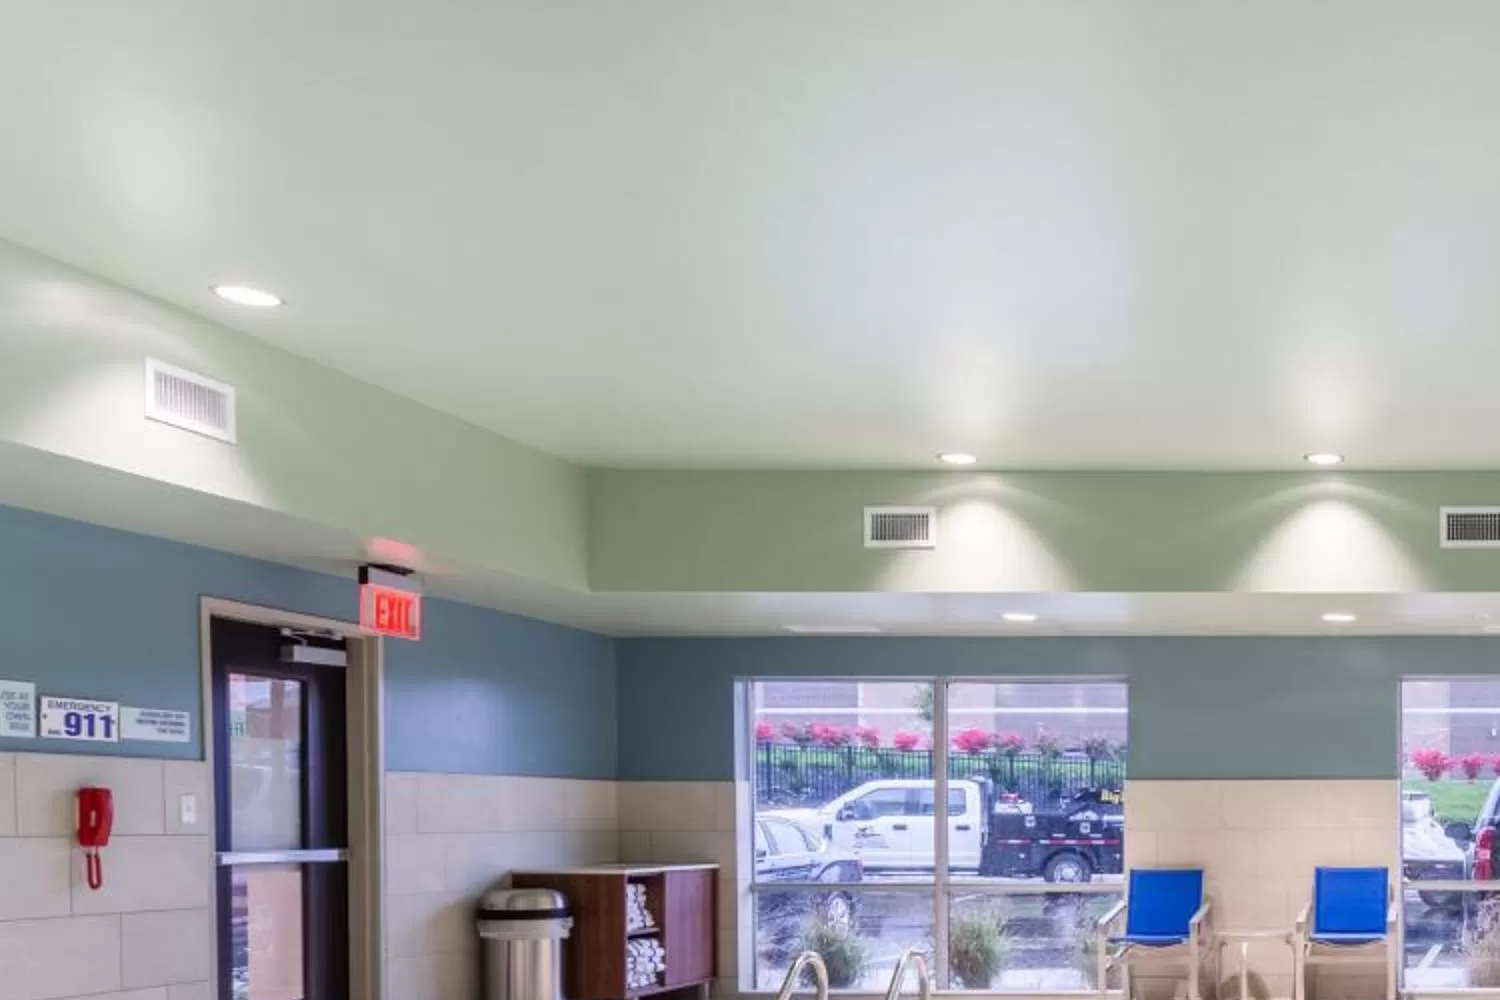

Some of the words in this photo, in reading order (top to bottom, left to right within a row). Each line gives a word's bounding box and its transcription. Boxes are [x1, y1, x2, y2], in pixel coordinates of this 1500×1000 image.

[375, 591, 413, 632] EXIT
[47, 700, 112, 712] EMERGENCY
[64, 712, 113, 738] 911
